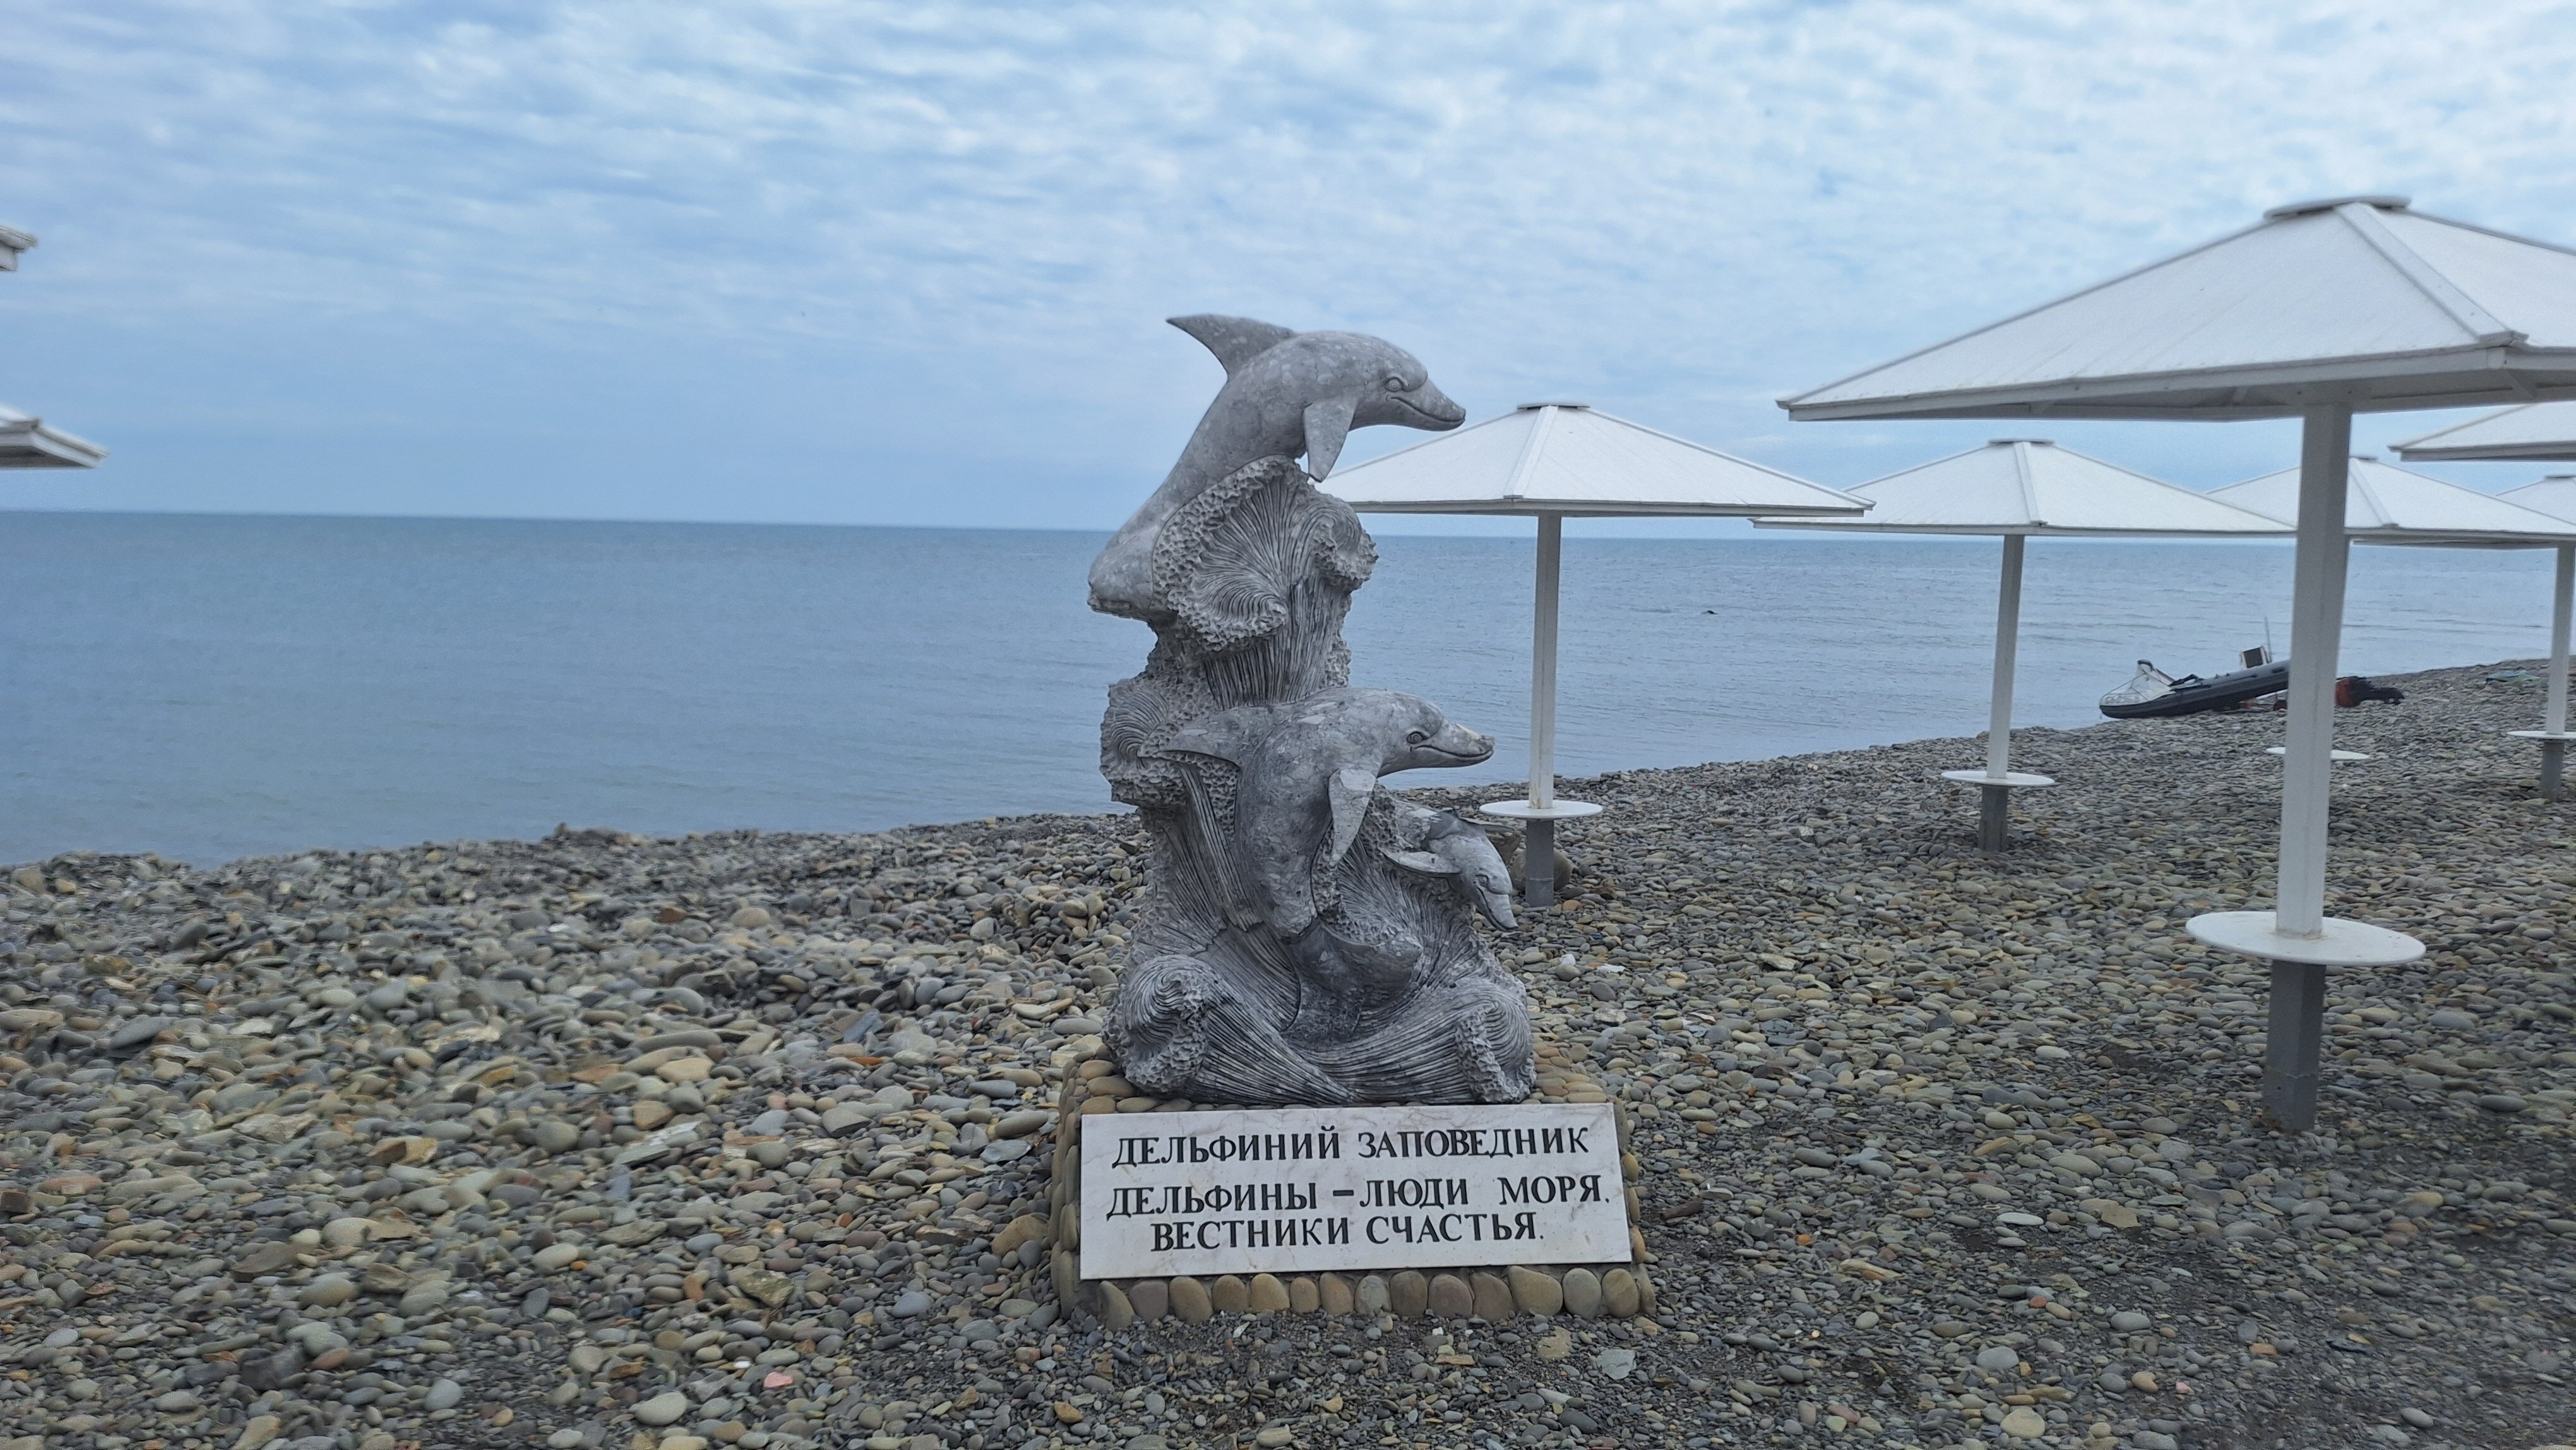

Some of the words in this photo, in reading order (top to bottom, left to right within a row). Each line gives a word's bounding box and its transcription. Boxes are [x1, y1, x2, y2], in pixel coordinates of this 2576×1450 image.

[1111, 1125, 1340, 1169] ДЕЛЬФИНИЙ
[1358, 1127, 1589, 1158] ЗАПОВЕДНИК
[1106, 1182, 1317, 1221] ДЕЛЬФИНЫ
[1496, 1175, 1610, 1206] МОРЯ.
[1150, 1217, 1349, 1252] ВЕСТНИКИ
[1365, 1211, 1545, 1245] СЧАСТЬЯ.
